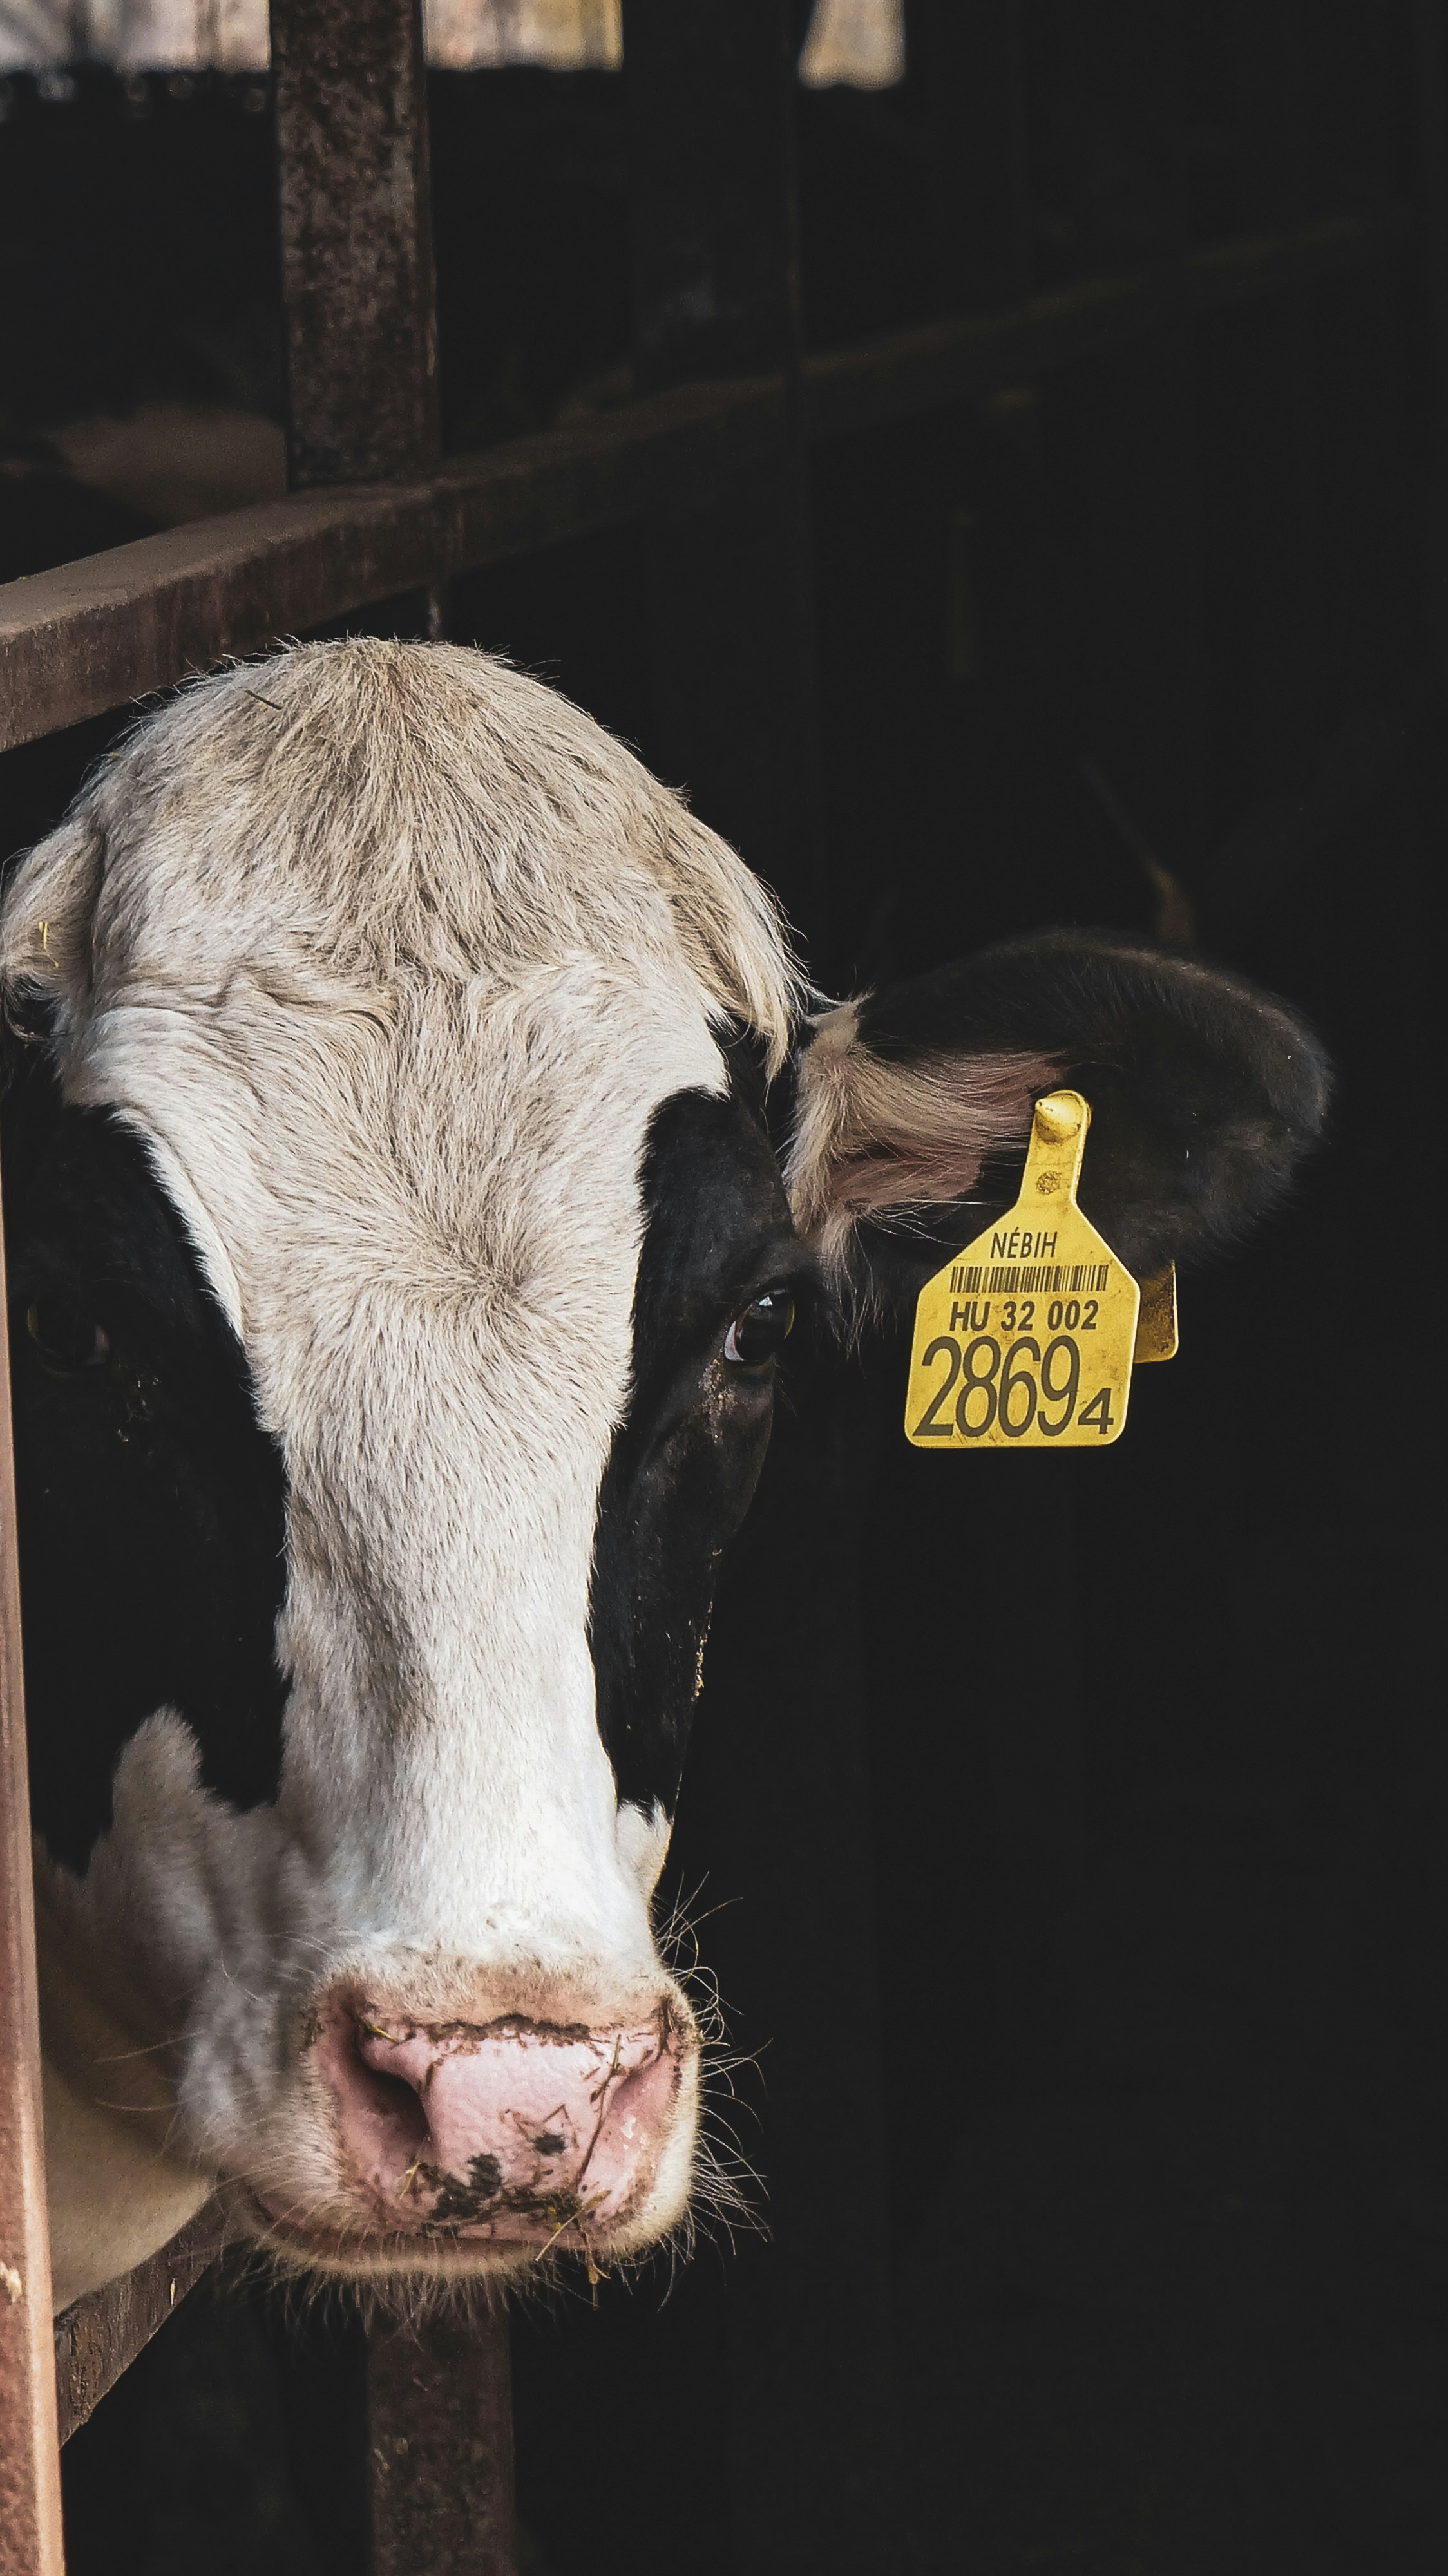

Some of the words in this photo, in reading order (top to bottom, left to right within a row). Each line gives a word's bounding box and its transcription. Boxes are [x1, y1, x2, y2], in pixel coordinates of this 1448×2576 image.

[991, 1227, 1058, 1258] NÉBIH
[949, 1301, 991, 1331] HU
[1001, 1300, 1035, 1331] 32
[1047, 1300, 1099, 1330] 002
